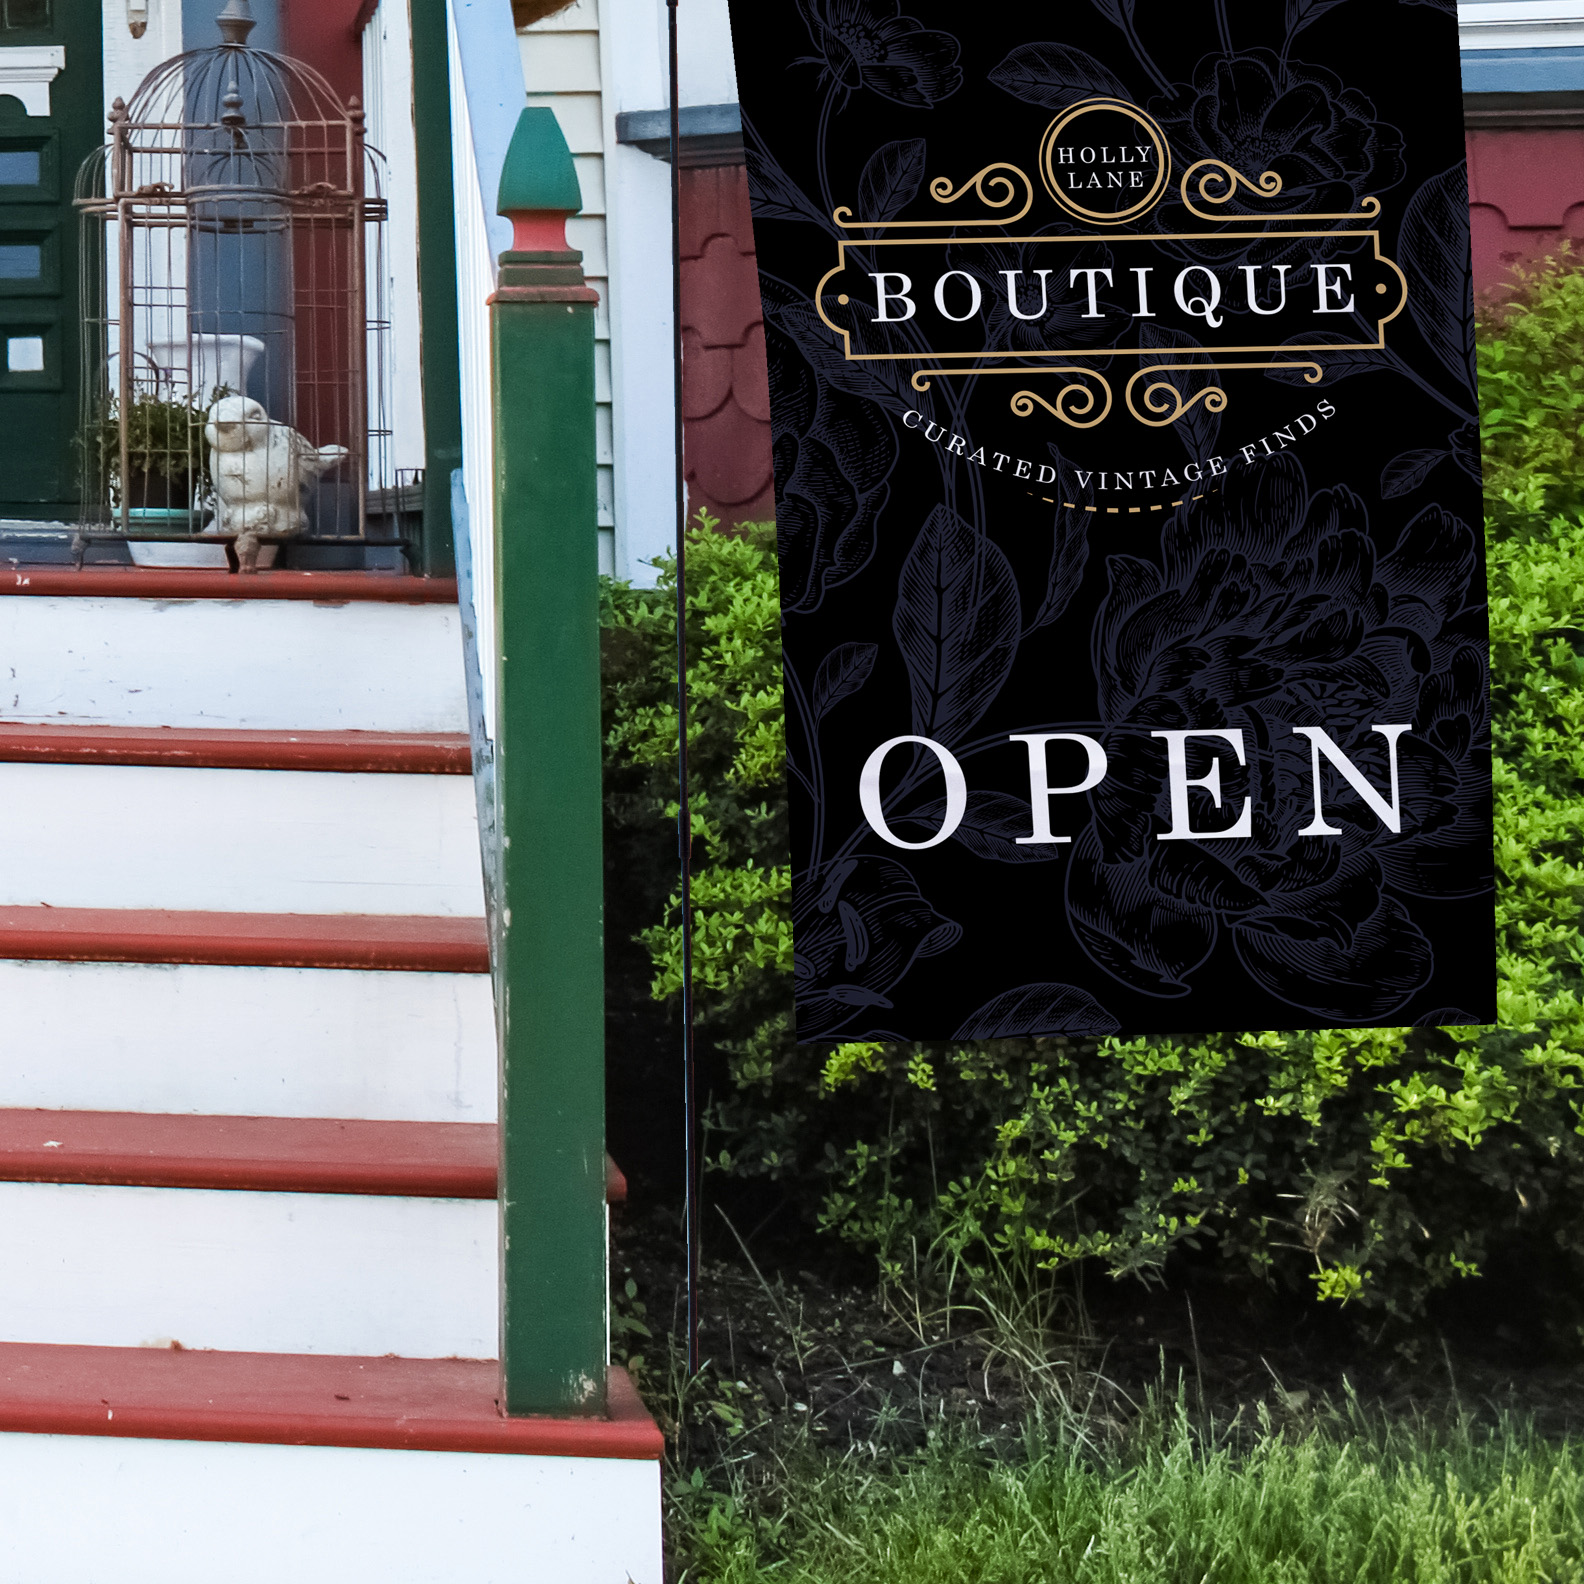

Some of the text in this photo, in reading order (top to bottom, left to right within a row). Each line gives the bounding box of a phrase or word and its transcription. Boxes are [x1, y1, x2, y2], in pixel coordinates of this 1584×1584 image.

[1058, 146, 1150, 163] HOLLY
[1068, 172, 1143, 188] LANE
[868, 264, 1354, 328] BOUTIQUE
[903, 399, 1335, 489] CURATED VINTAGE FINDS
[860, 724, 1412, 849] OPEN
